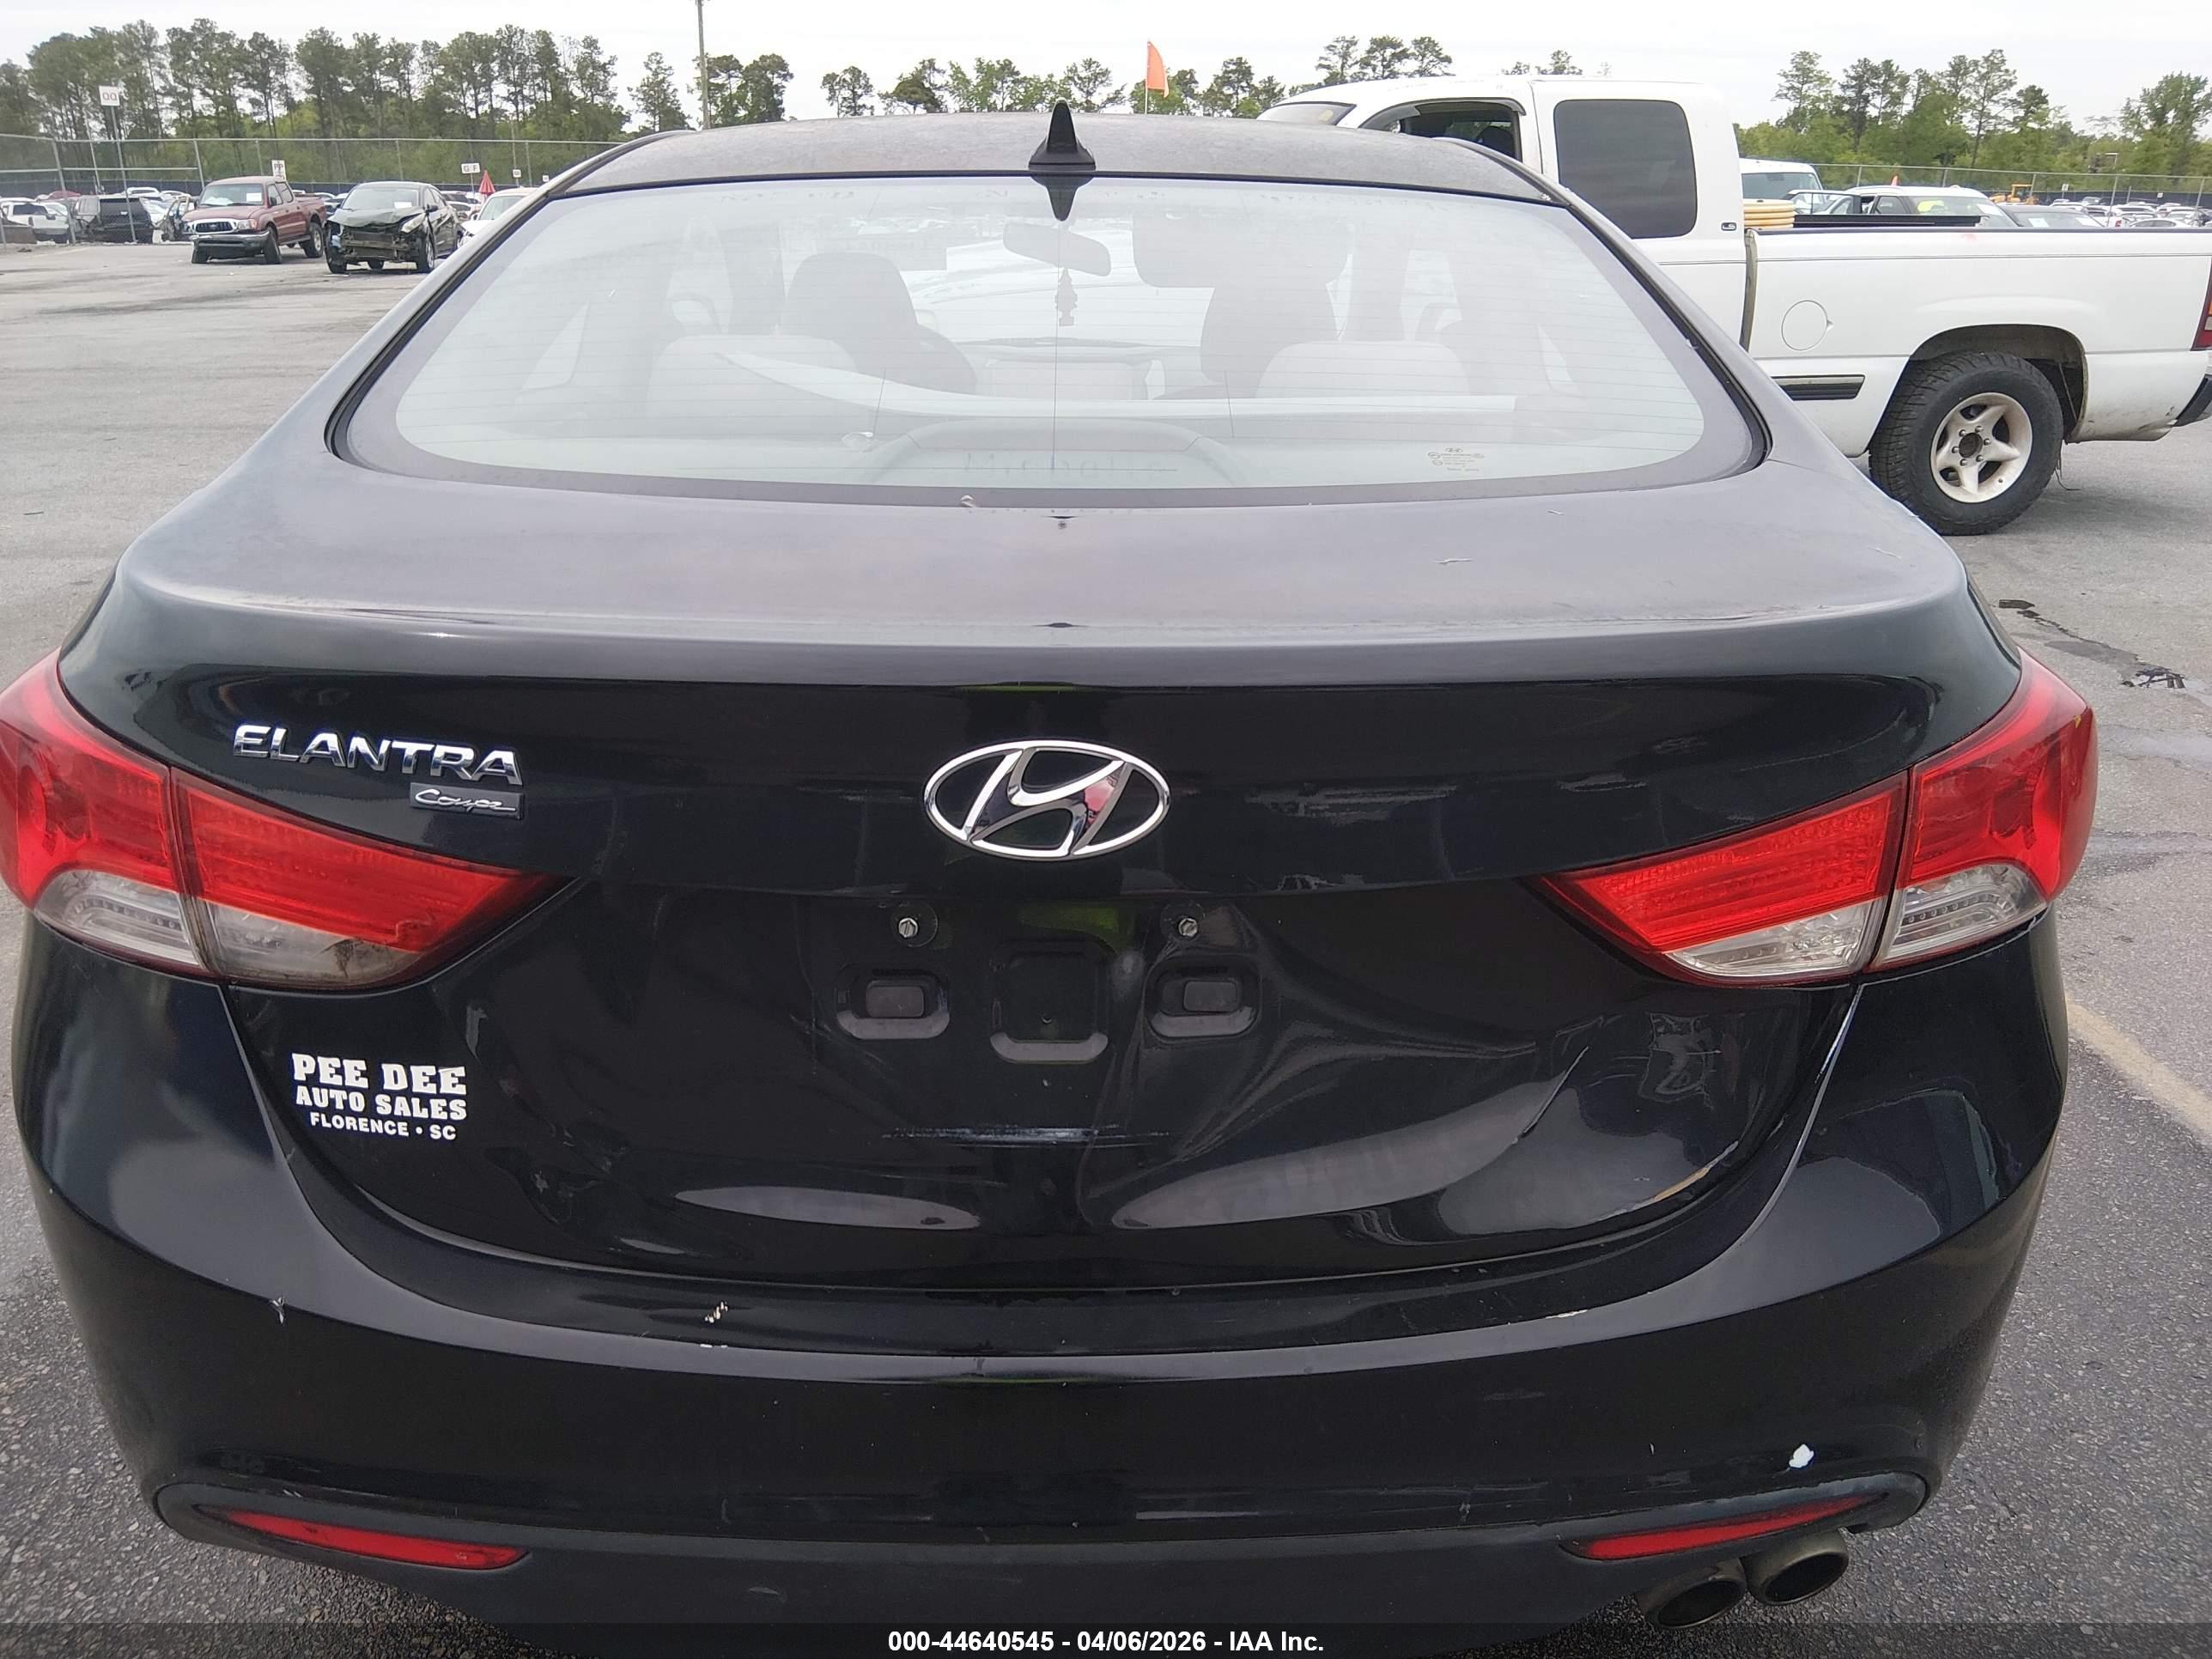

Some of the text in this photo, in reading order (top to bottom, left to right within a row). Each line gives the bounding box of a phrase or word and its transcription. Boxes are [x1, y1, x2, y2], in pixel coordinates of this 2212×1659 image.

[233, 724, 523, 785] ELANTRA
[415, 788, 516, 813] Coupe
[291, 1053, 466, 1095] PEE DEE
[295, 1086, 467, 1121] AUTO SALES
[310, 1112, 410, 1137] FLORENCE
[429, 1124, 457, 1140] SC
